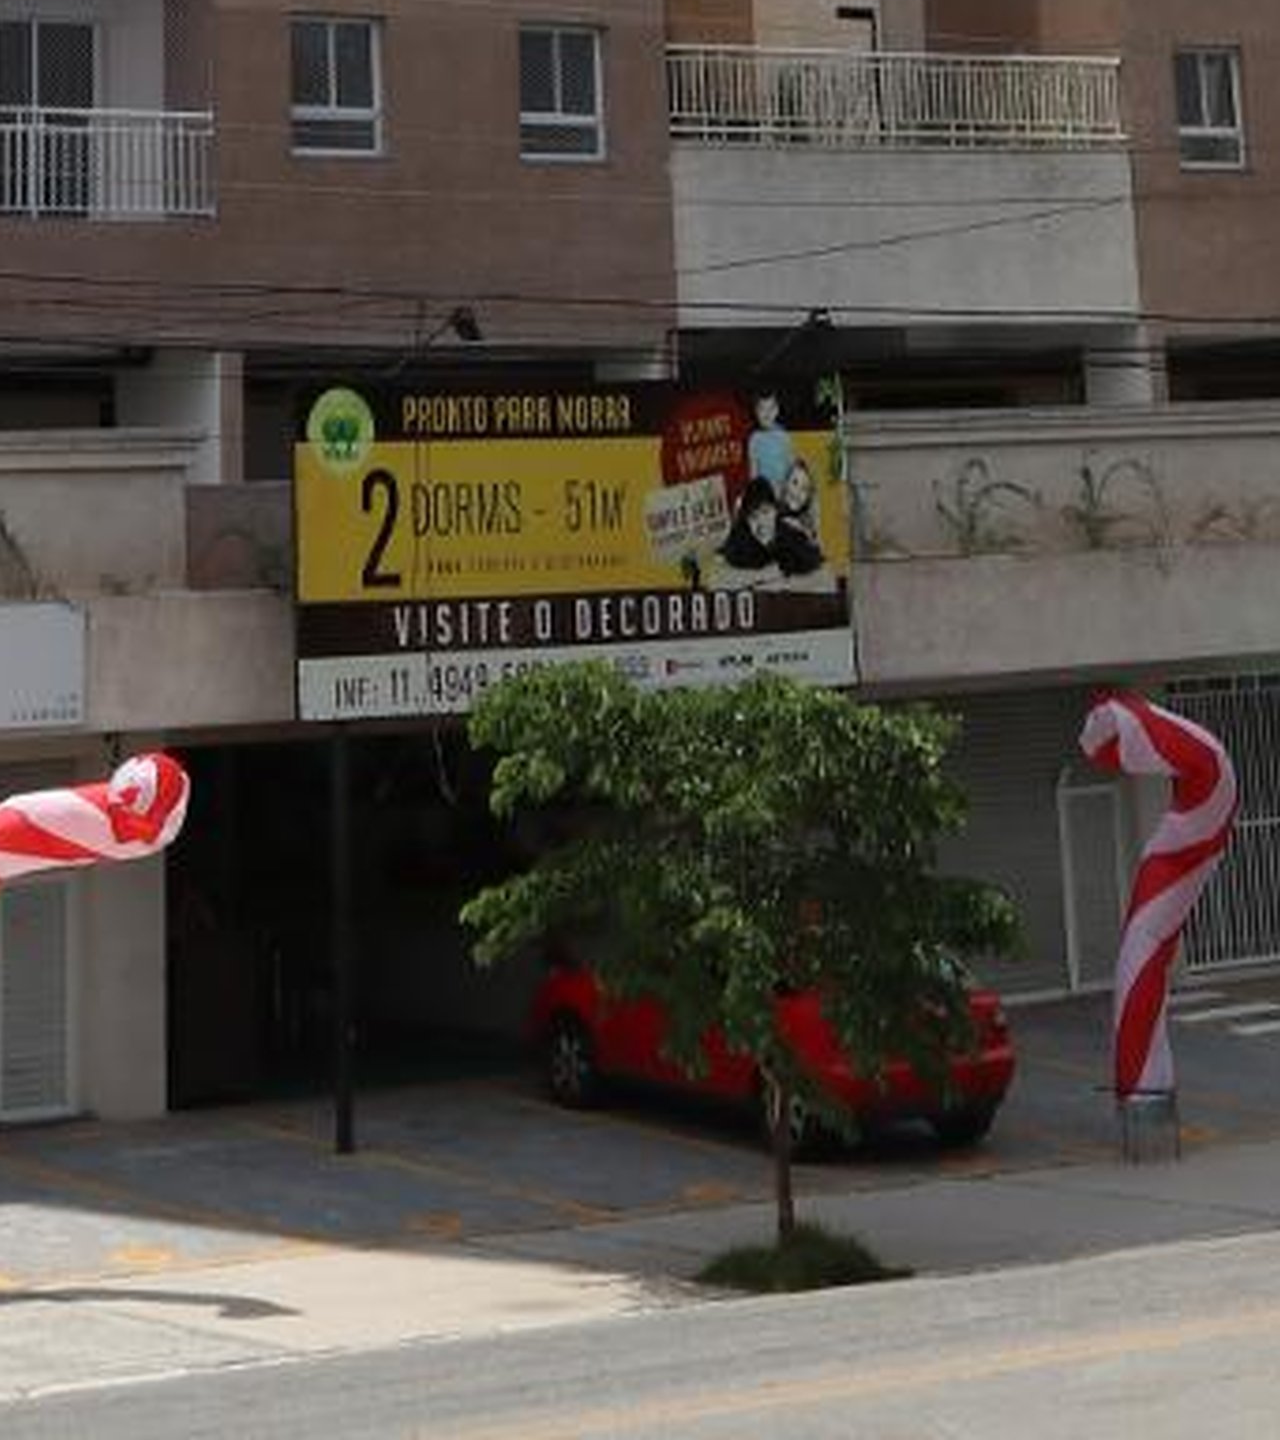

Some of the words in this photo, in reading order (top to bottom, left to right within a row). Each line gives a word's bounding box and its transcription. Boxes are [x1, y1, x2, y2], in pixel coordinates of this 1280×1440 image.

[402, 395, 487, 433] PRONTO
[361, 468, 401, 588] 2
[394, 602, 511, 647] VISITE
[534, 600, 552, 640] O
[575, 591, 755, 639] DECORADO
